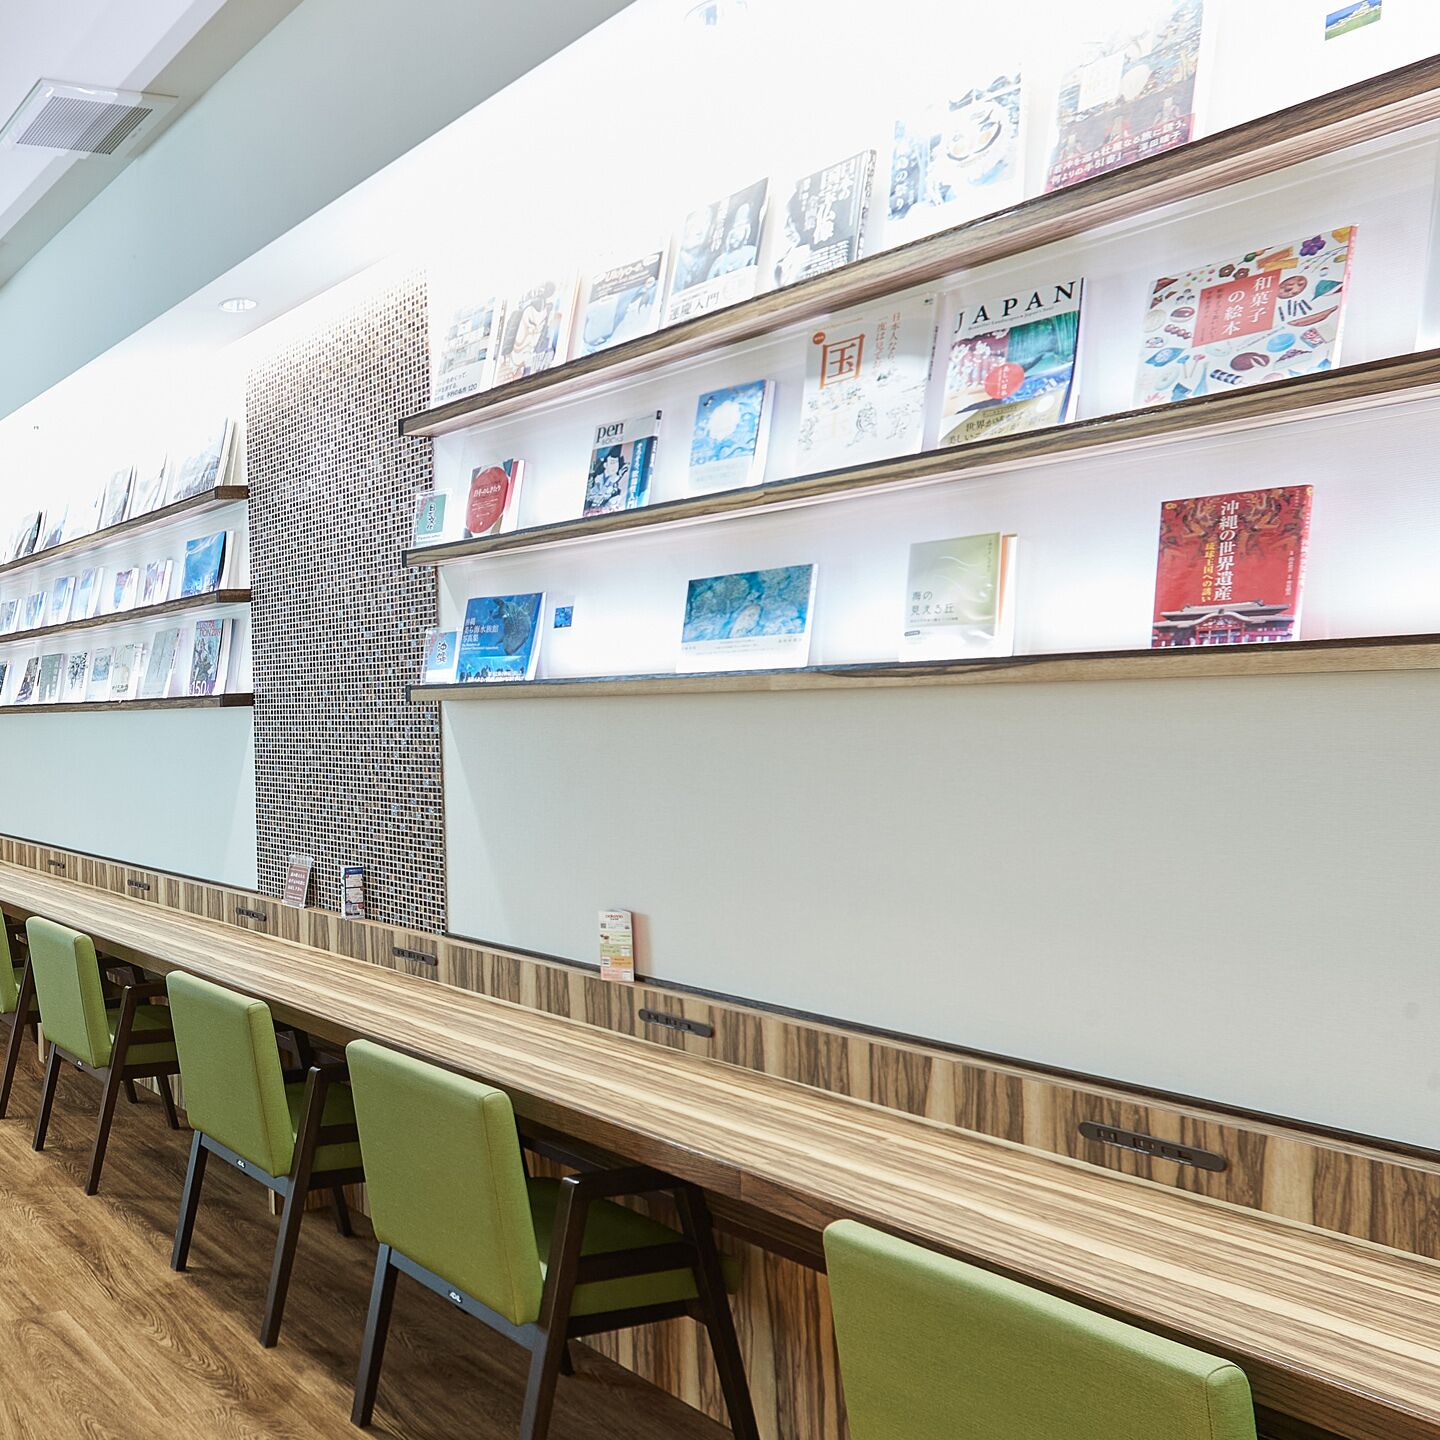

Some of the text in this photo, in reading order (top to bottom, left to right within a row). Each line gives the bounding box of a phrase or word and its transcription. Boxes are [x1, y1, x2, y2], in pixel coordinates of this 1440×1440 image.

[954, 281, 1076, 334] JAPAN
[1222, 290, 1246, 336] の絵本
[1247, 274, 1276, 323] 和菓子
[819, 333, 865, 390] 国
[596, 422, 625, 444] pen
[1201, 542, 1217, 603] 琉球王国への誘い
[1213, 499, 1240, 601] 沖縄の世界遺産
[910, 602, 955, 616] 見える丘
